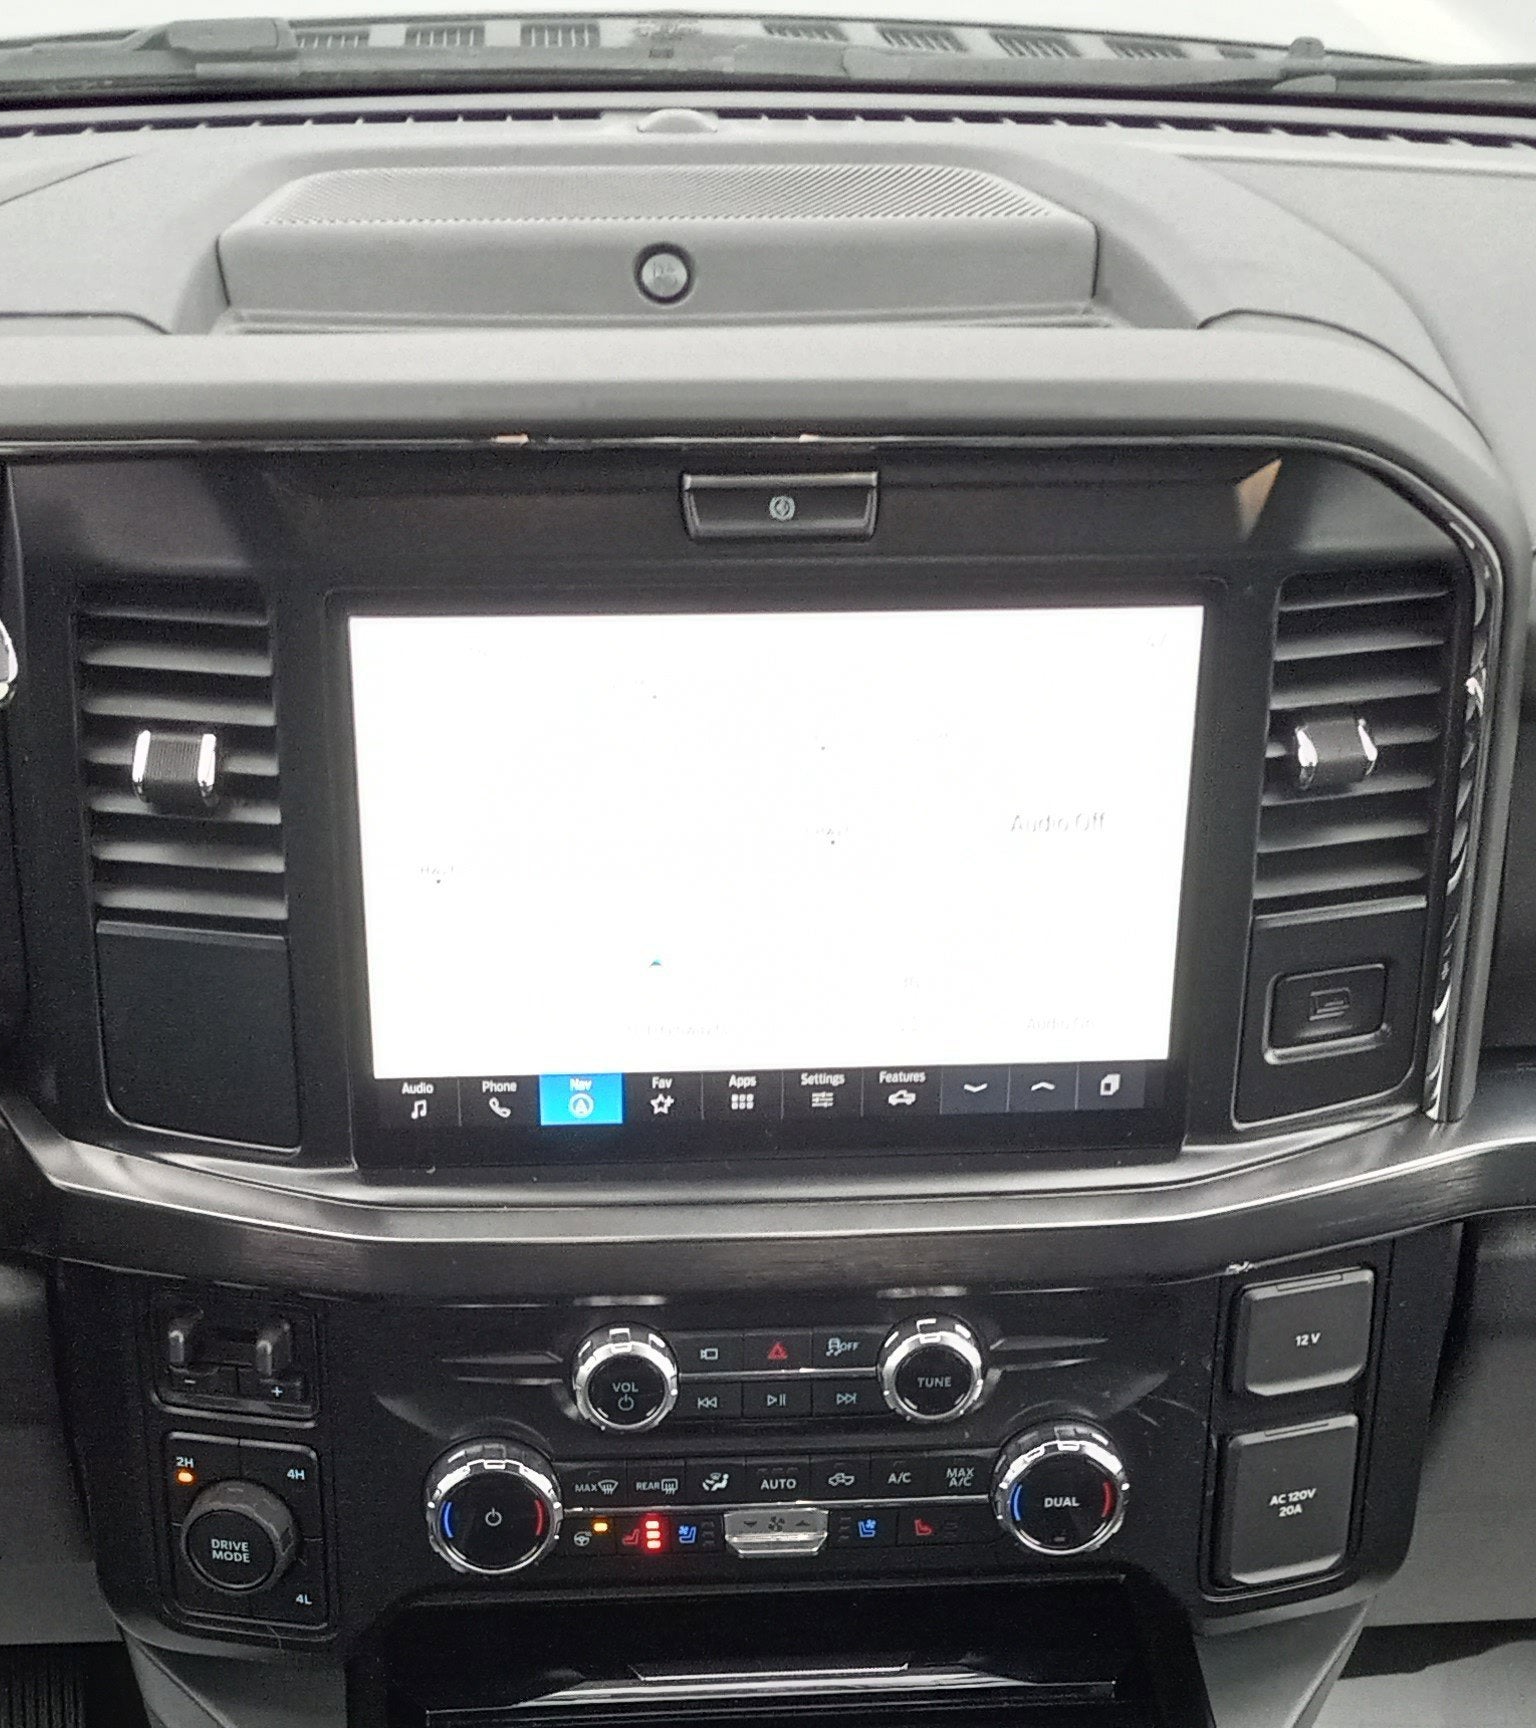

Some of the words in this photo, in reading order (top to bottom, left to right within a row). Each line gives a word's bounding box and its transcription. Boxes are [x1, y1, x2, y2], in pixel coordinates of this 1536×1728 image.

[652, 1076, 673, 1089] Fav
[729, 1074, 757, 1089] Apps
[800, 1071, 846, 1086] Settings
[879, 1070, 926, 1084] Features
[402, 1082, 434, 1095] Audio
[482, 1080, 517, 1093] Phone
[570, 1077, 591, 1091] Nav
[840, 1341, 859, 1350] OFF
[612, 1382, 639, 1393] VOL
[917, 1376, 952, 1388] TUNE
[176, 1457, 194, 1468] 2H
[287, 1469, 305, 1480] 4H
[888, 1472, 912, 1484] A/C
[946, 1467, 975, 1478] MAX
[636, 1482, 660, 1491] REAR
[760, 1478, 797, 1490] AUTO
[949, 1476, 972, 1487] A/C
[574, 1483, 598, 1493] MAX
[1044, 1495, 1080, 1509] DUAL
[1269, 1493, 1286, 1506] AC
[1287, 1489, 1316, 1502] 120V
[1278, 1504, 1302, 1517] 20A
[211, 1539, 249, 1552] DRIVE
[212, 1550, 251, 1563] MODE
[296, 1594, 312, 1605] 4L
